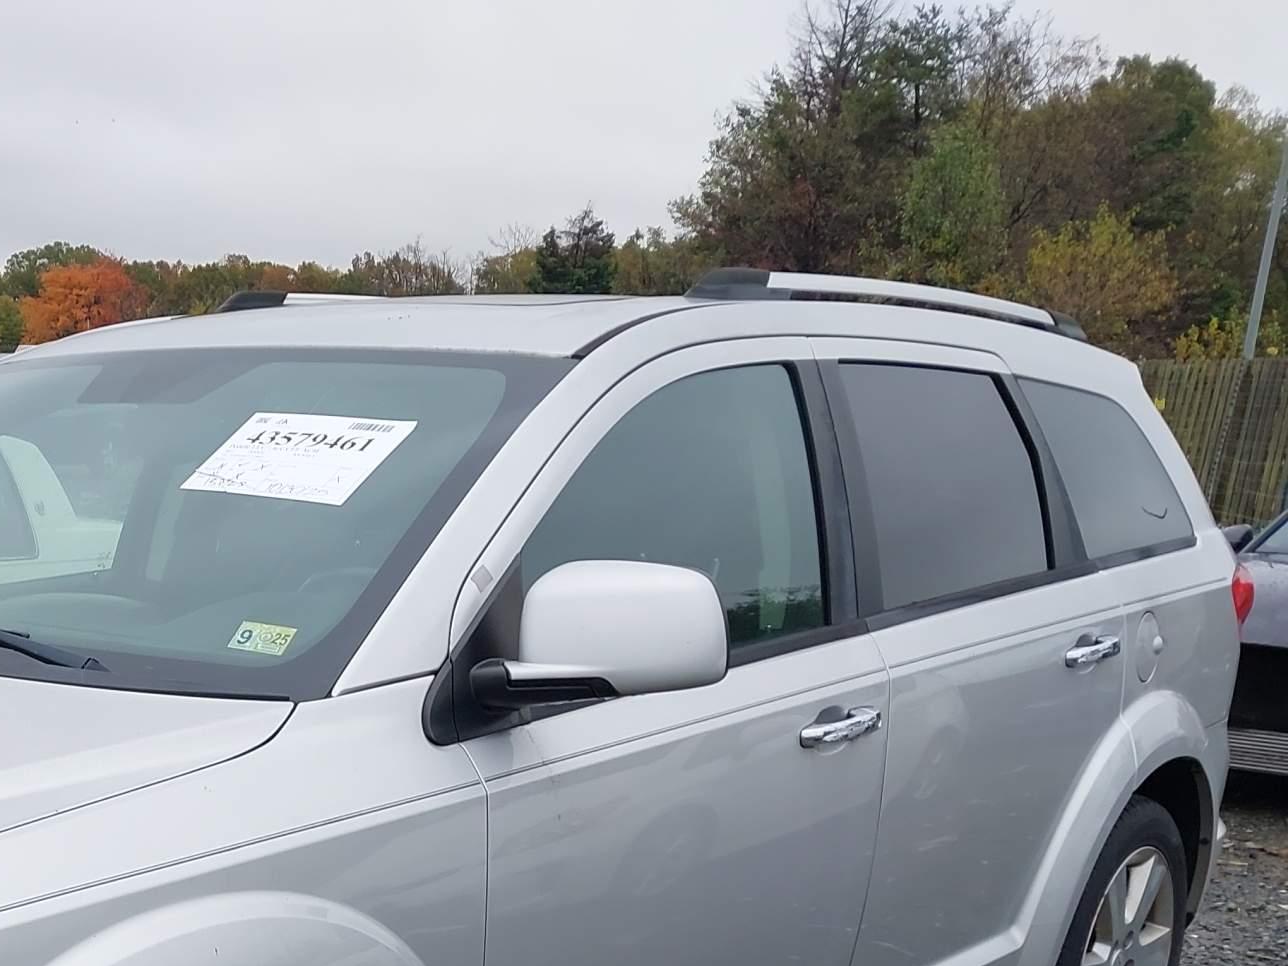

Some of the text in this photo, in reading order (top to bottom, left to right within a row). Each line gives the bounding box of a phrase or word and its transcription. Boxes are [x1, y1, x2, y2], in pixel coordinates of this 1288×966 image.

[246, 430, 375, 451] 43579461
[236, 629, 291, 646] 9 25
